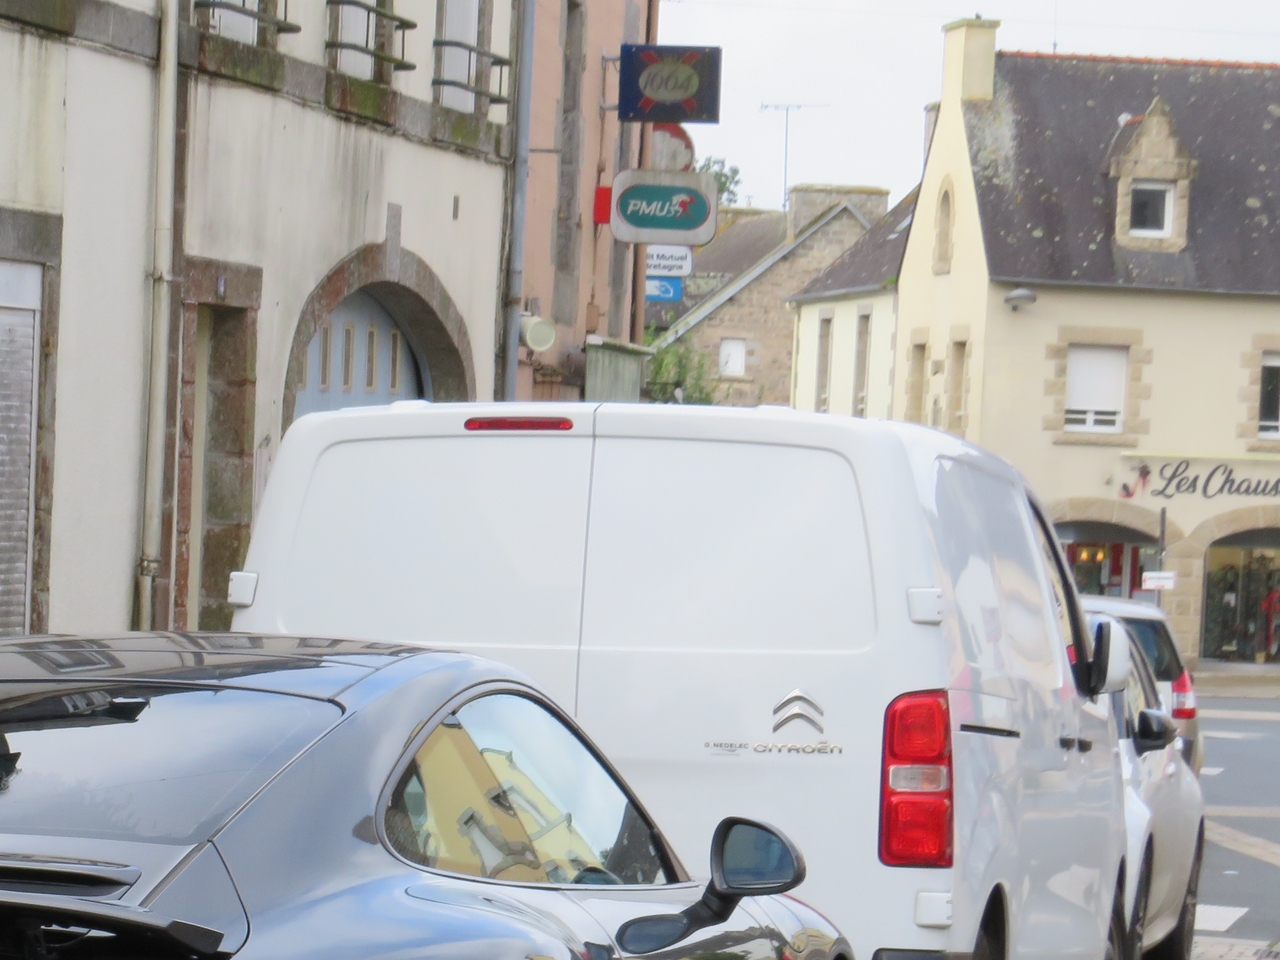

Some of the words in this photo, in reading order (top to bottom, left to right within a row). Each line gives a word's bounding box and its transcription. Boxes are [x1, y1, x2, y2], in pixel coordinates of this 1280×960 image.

[626, 199, 670, 216] PMU
[656, 253, 688, 261] Mutuel
[1150, 460, 1200, 498] Les
[753, 741, 843, 755] CITROËN
